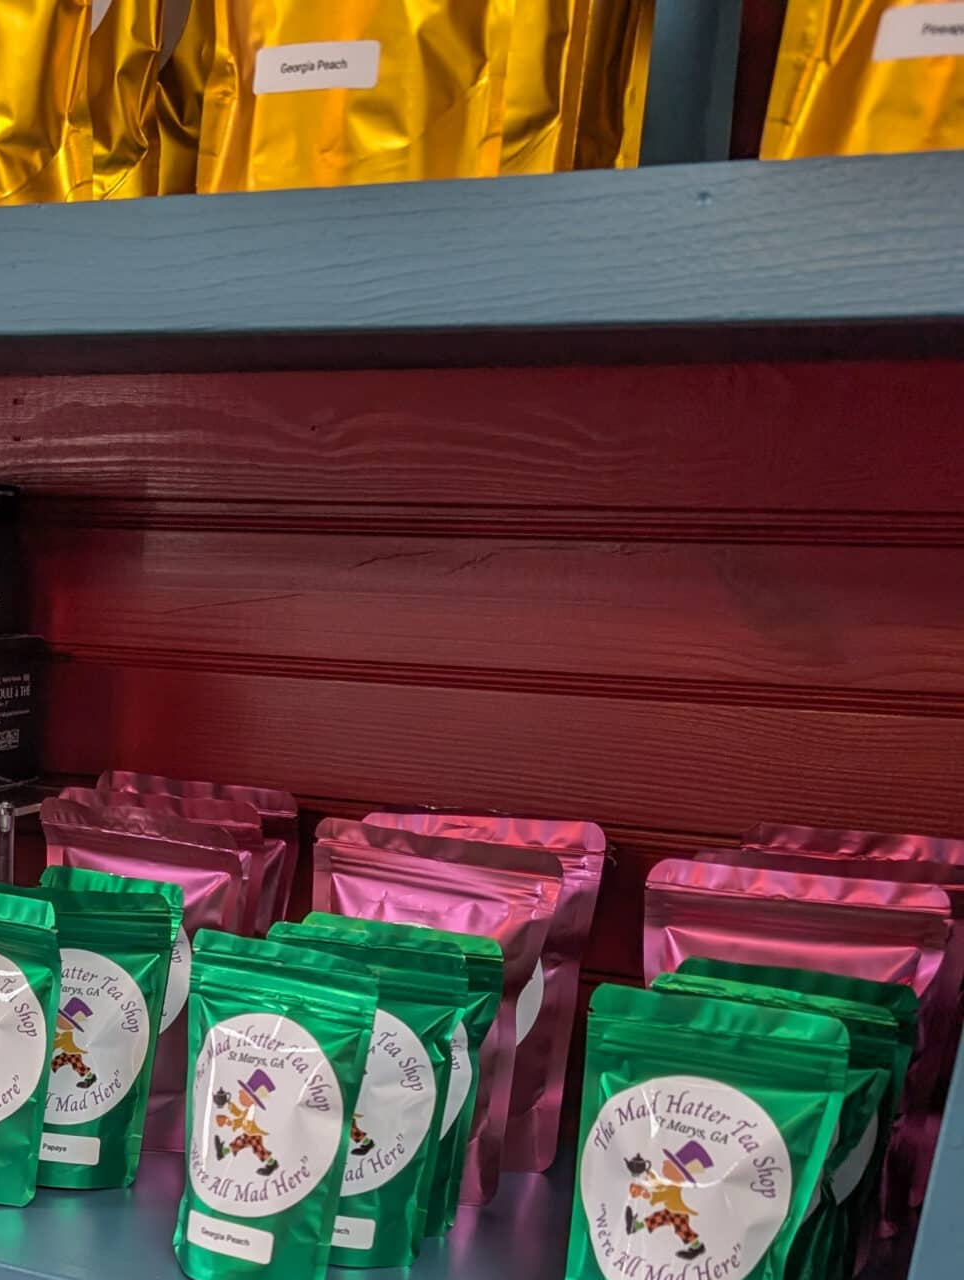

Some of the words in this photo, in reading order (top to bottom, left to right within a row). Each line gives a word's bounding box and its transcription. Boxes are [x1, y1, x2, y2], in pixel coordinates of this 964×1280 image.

[280, 61, 315, 74] Georgia
[317, 59, 348, 72] Peach
[102, 975, 124, 1002] Tea
[121, 999, 140, 1034] Shop
[306, 1074, 332, 1113] Shop
[594, 1120, 616, 1152] The
[616, 1090, 661, 1124] Mad
[666, 1091, 731, 1125] Hatter
[732, 1120, 761, 1153] Tea
[749, 1156, 777, 1199] Shop
[667, 1120, 706, 1139] Marys,
[710, 1130, 729, 1145] GA
[43, 1143, 68, 1154] Papaya
[211, 1177, 227, 1200] All
[235, 1183, 269, 1203] Mad
[200, 1226, 225, 1242] Georgia
[225, 1232, 250, 1247] Peach
[614, 1253, 638, 1278] All
